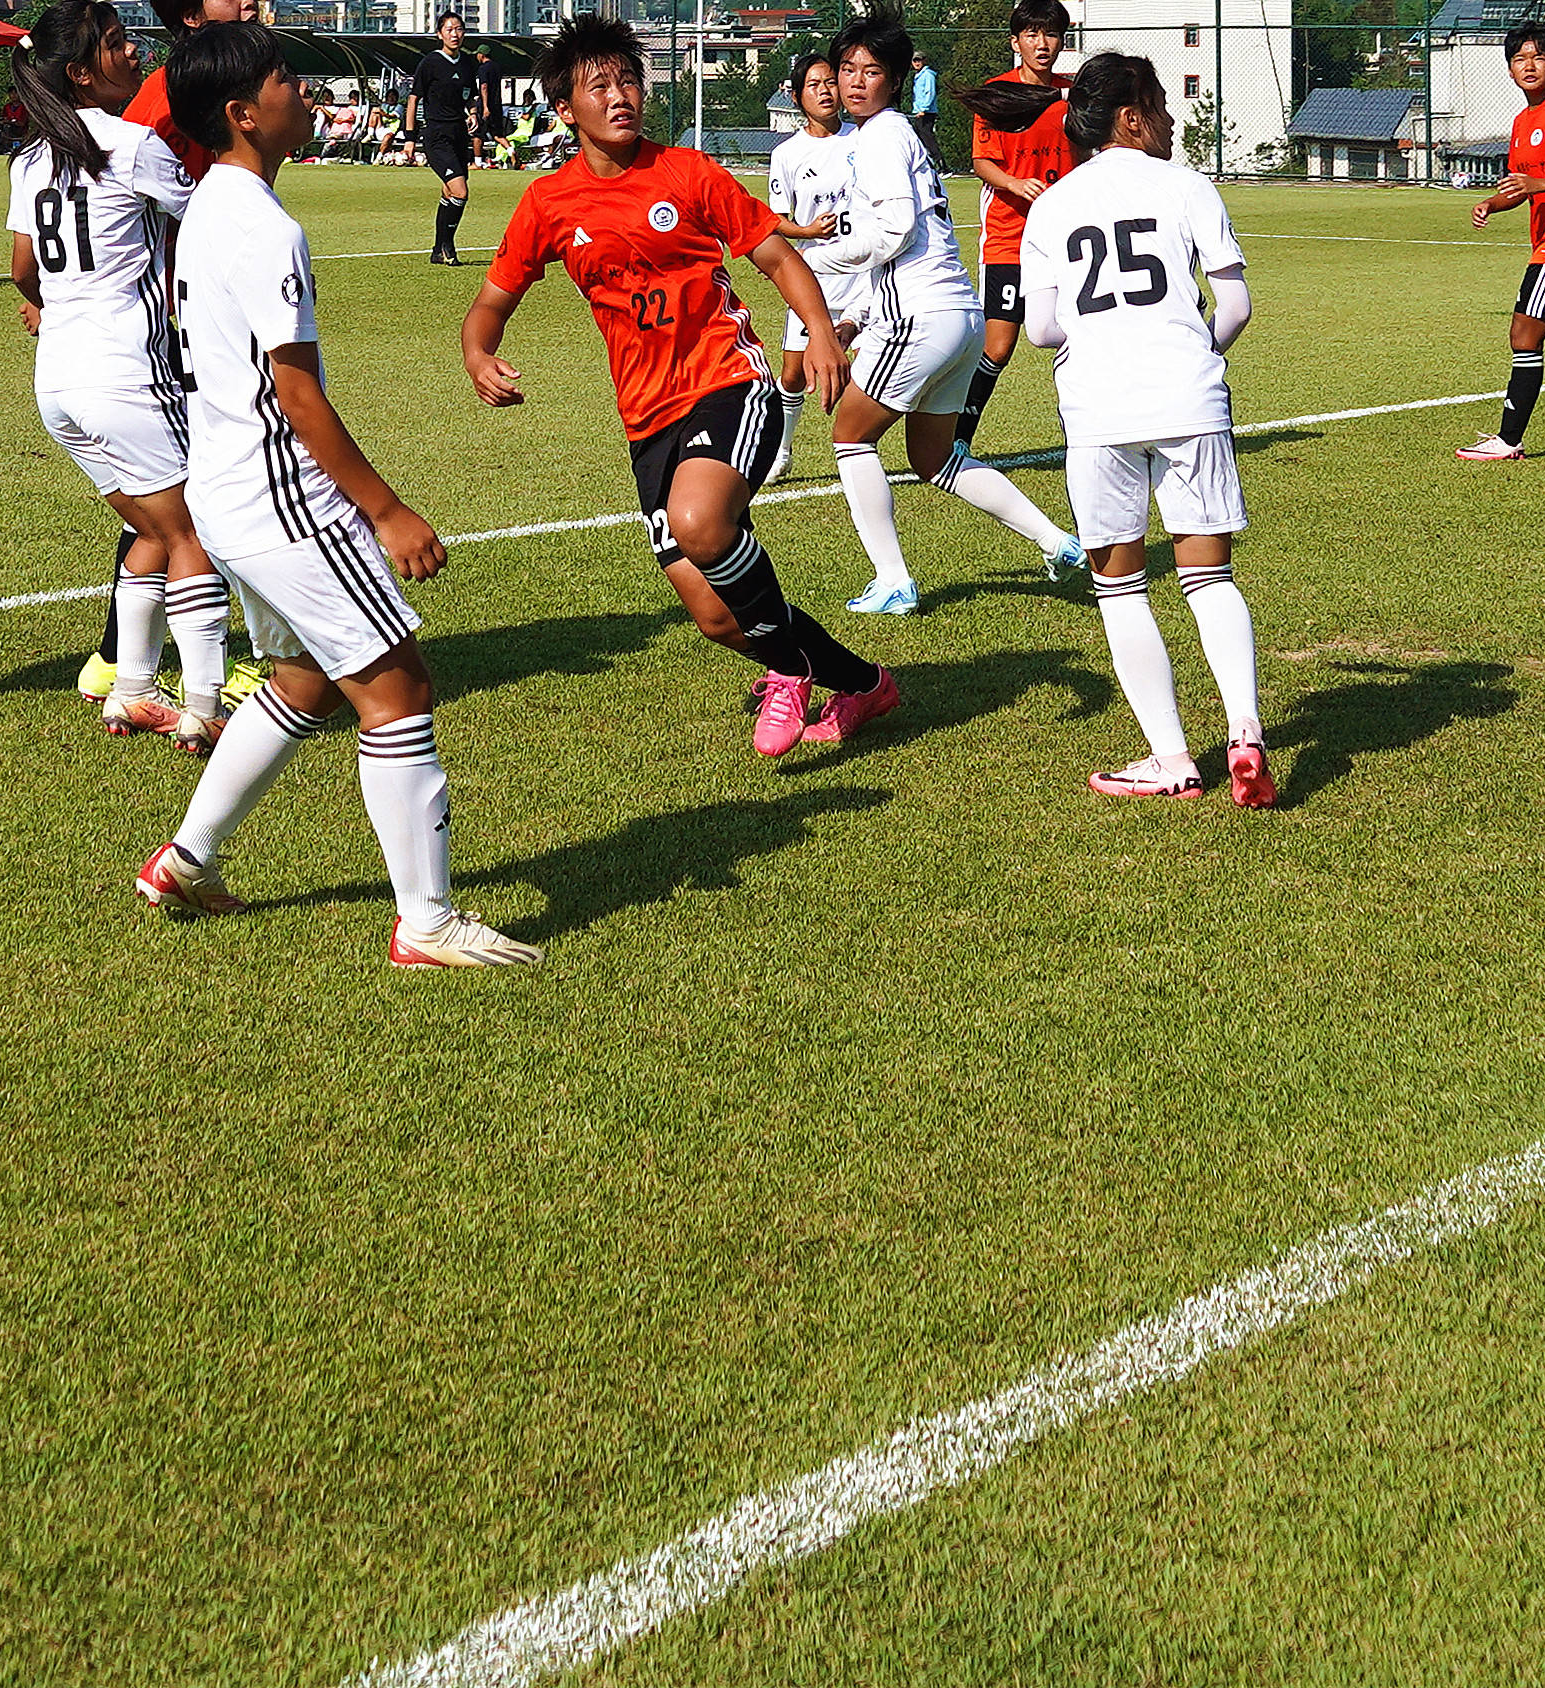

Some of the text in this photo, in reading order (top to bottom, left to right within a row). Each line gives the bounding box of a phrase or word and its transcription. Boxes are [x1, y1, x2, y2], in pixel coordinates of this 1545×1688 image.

[34, 185, 95, 274] 81
[1001, 283, 1017, 311] 9
[1066, 217, 1168, 316] 25
[631, 288, 676, 332] 22
